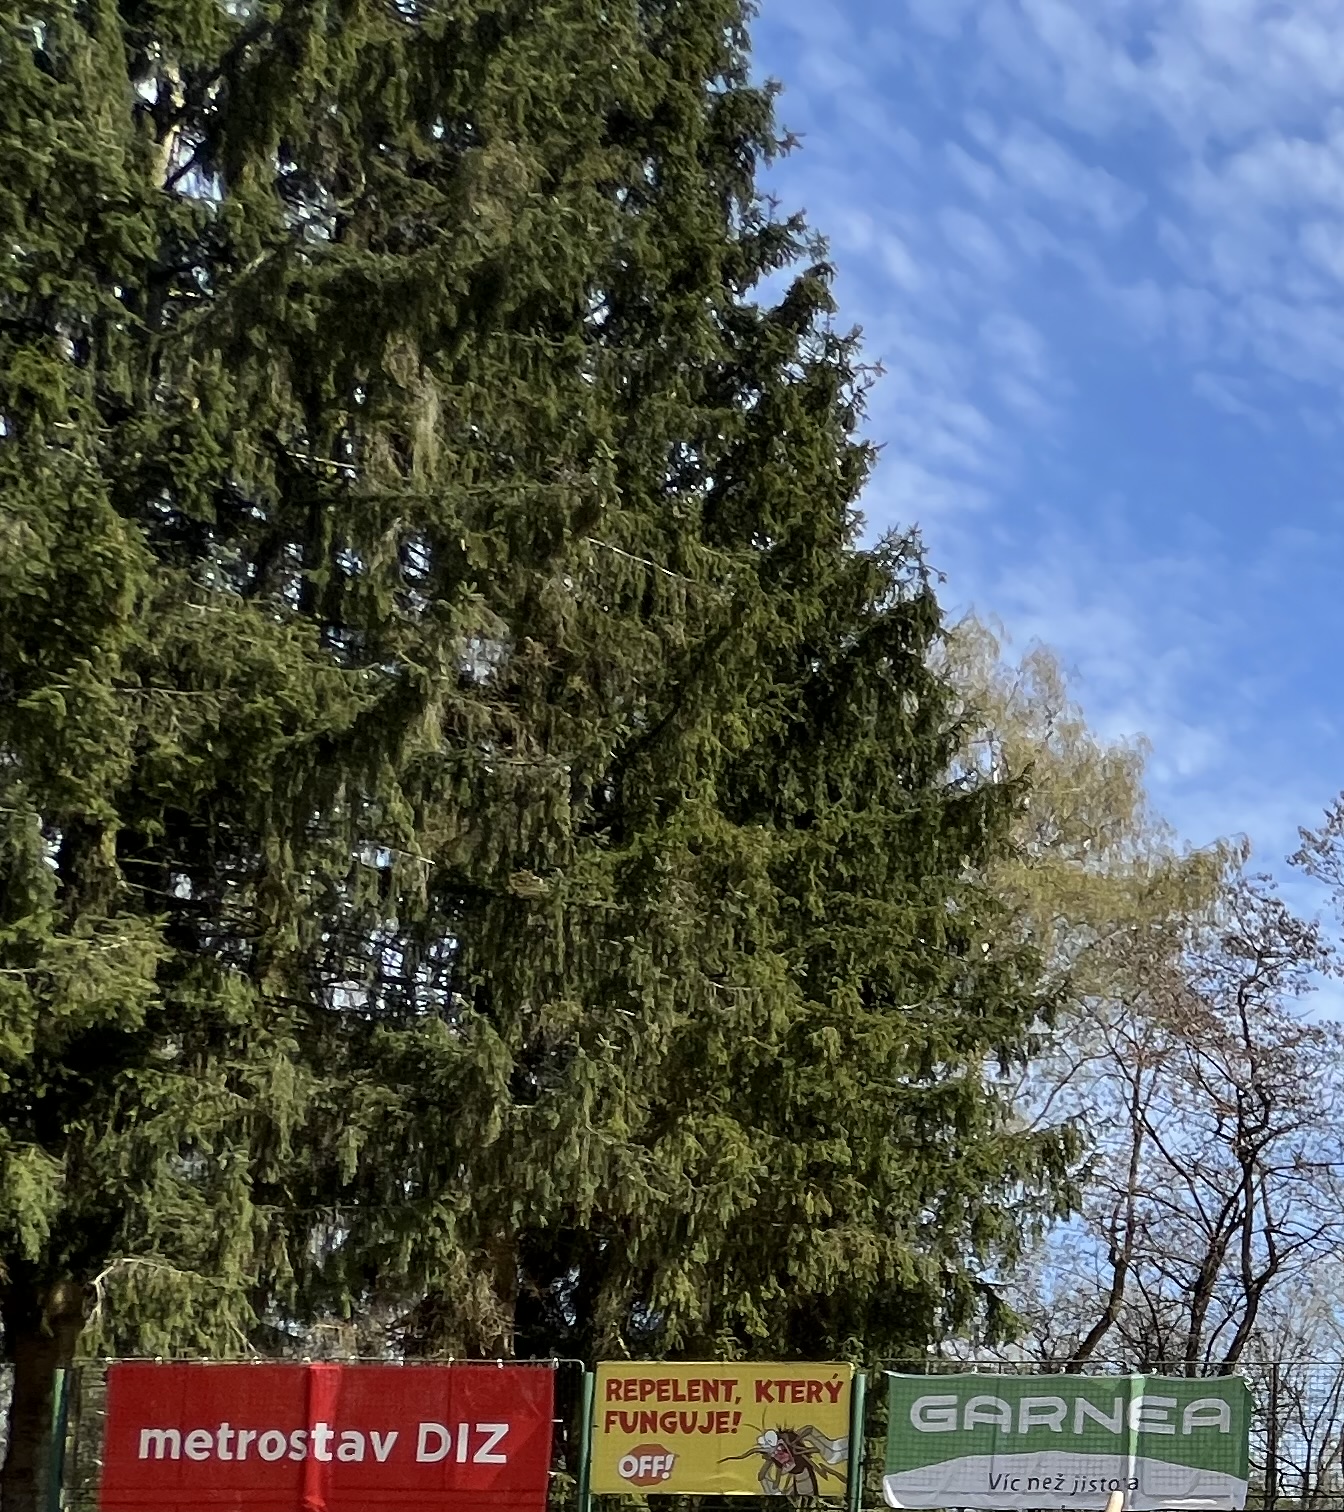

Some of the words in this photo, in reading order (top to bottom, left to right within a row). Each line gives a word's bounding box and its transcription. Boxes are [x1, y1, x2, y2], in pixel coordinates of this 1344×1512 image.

[606, 1378, 742, 1404] REPELENT,
[755, 1373, 844, 1404] KTERÝ
[604, 1411, 742, 1434] FUNGUJE!
[910, 1395, 1232, 1434] GARNEA
[138, 1422, 398, 1463] metrostav
[416, 1422, 508, 1464] DIZ
[618, 1454, 675, 1480] OFF!
[988, 1473, 1021, 1491] Víc
[1028, 1473, 1066, 1491] než
